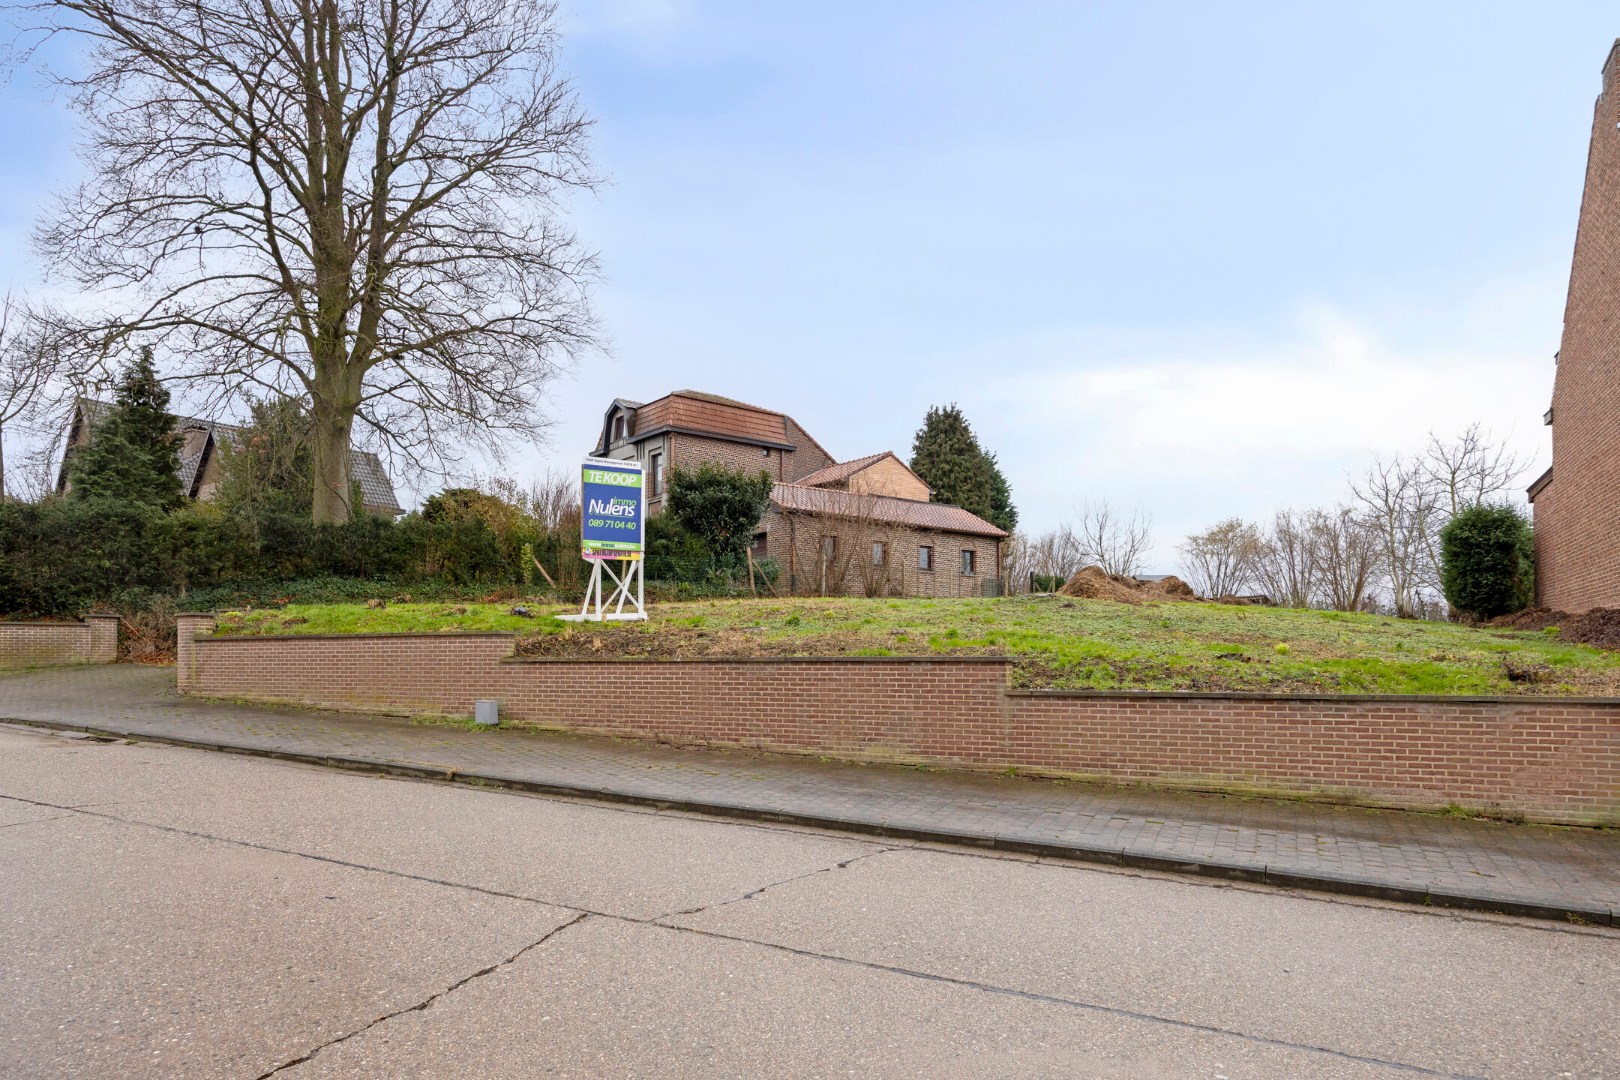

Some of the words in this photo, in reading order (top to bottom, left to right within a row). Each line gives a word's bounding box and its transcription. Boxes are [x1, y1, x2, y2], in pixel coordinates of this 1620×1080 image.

[589, 471, 602, 482] TE
[603, 472, 637, 486] KOOP
[588, 498, 635, 517] Nulens
[613, 496, 637, 506] immo
[588, 519, 604, 527] 089
[605, 520, 614, 528] 71
[615, 521, 625, 529] 04
[626, 522, 636, 530] 40
